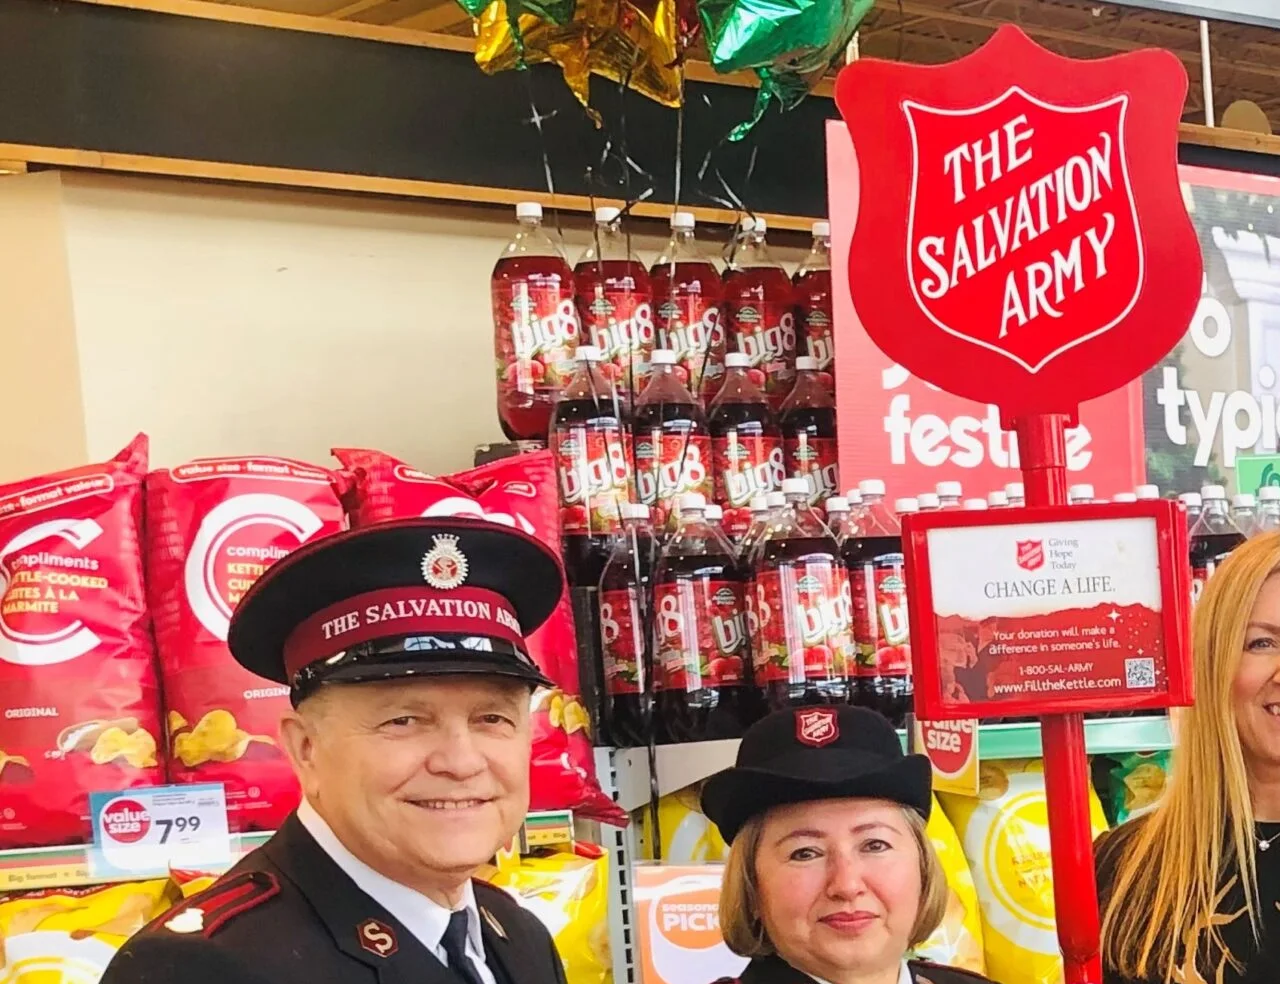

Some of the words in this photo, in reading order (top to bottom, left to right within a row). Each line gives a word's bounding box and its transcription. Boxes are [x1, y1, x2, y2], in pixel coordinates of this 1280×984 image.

[943, 114, 1035, 204] THE
[918, 132, 1113, 299] SALVATION
[999, 212, 1115, 338] ARMY
[511, 299, 578, 360] big8
[590, 303, 655, 357] big8
[737, 312, 796, 367] big8
[560, 443, 628, 503] big8
[637, 445, 705, 504] big8
[724, 447, 787, 506] big8
[1048, 538, 1079, 548] Giving
[227, 546, 290, 561] complim
[1050, 550, 1073, 560] Hope
[1051, 561, 1077, 570] Today
[59, 590, 81, 601] LA
[984, 578, 1057, 599] CHANGE
[1061, 577, 1076, 595] A
[1077, 575, 1116, 594] LIFE.
[322, 613, 361, 640] THE
[366, 598, 491, 625] SALVATION
[993, 630, 1016, 641] Your
[1017, 627, 1059, 640] donation
[1061, 627, 1080, 638] will
[1081, 626, 1107, 637] make
[1109, 627, 1116, 635] a
[989, 642, 1038, 656] difference
[1040, 642, 1049, 652] in
[1050, 638, 1101, 652] someone's
[1102, 637, 1121, 649] life.
[1018, 662, 1094, 677] 1-800-SAL-ARMY
[243, 687, 291, 700] ORIGIN
[993, 677, 1122, 694] www.FilltheKettle.com
[5, 707, 59, 719] ORIGINAL
[927, 729, 962, 753] size
[103, 807, 151, 823] value
[109, 821, 142, 834] size
